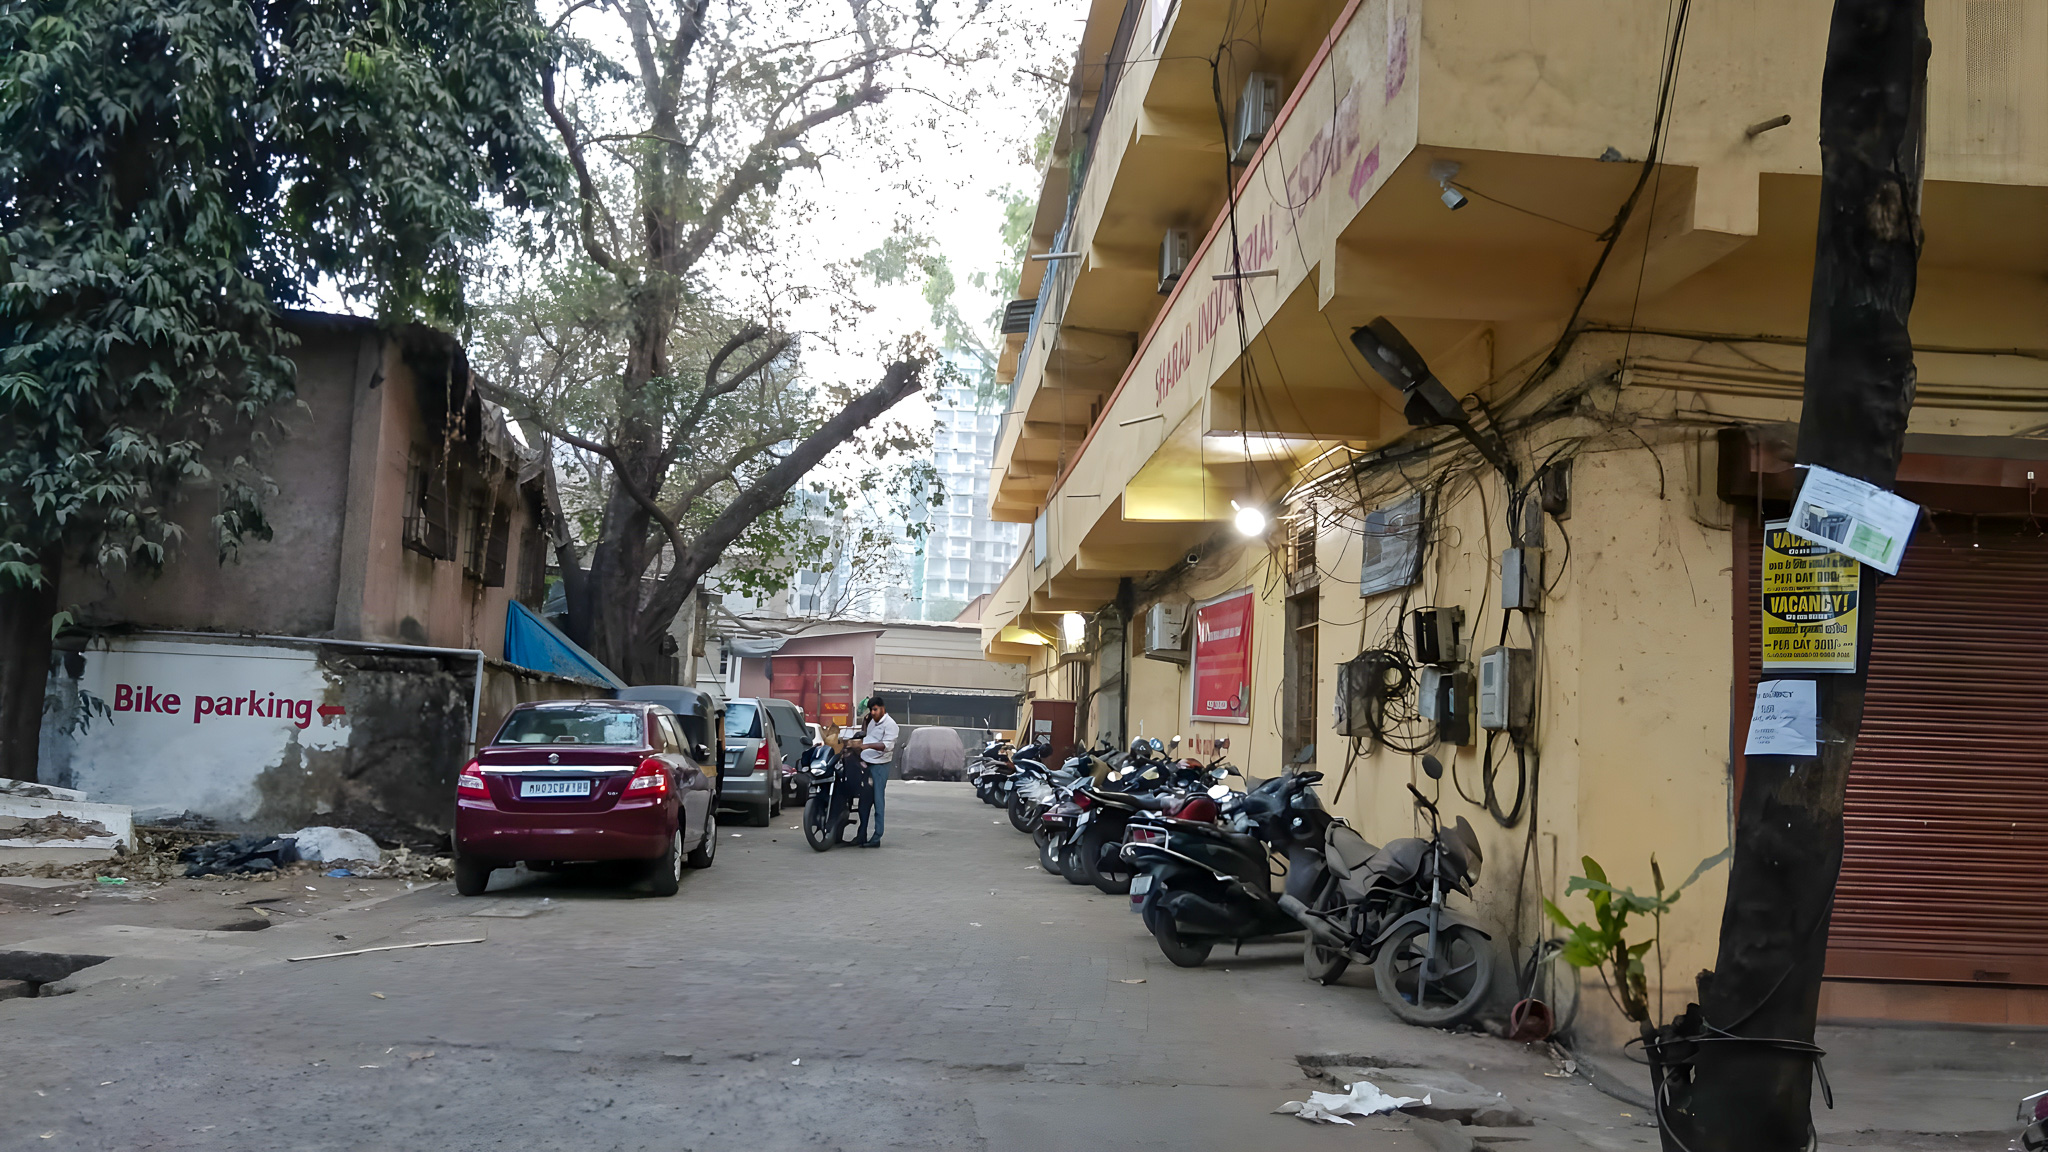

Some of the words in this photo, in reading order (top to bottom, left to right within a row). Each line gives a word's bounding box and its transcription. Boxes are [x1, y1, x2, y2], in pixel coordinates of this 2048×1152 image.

[1155, 320, 1193, 408] SHARAD
[1198, 203, 1278, 354] INDUSRIAL
[1770, 594, 1849, 613] VACANCY!
[114, 684, 181, 714] Bike
[193, 690, 312, 729] parking
